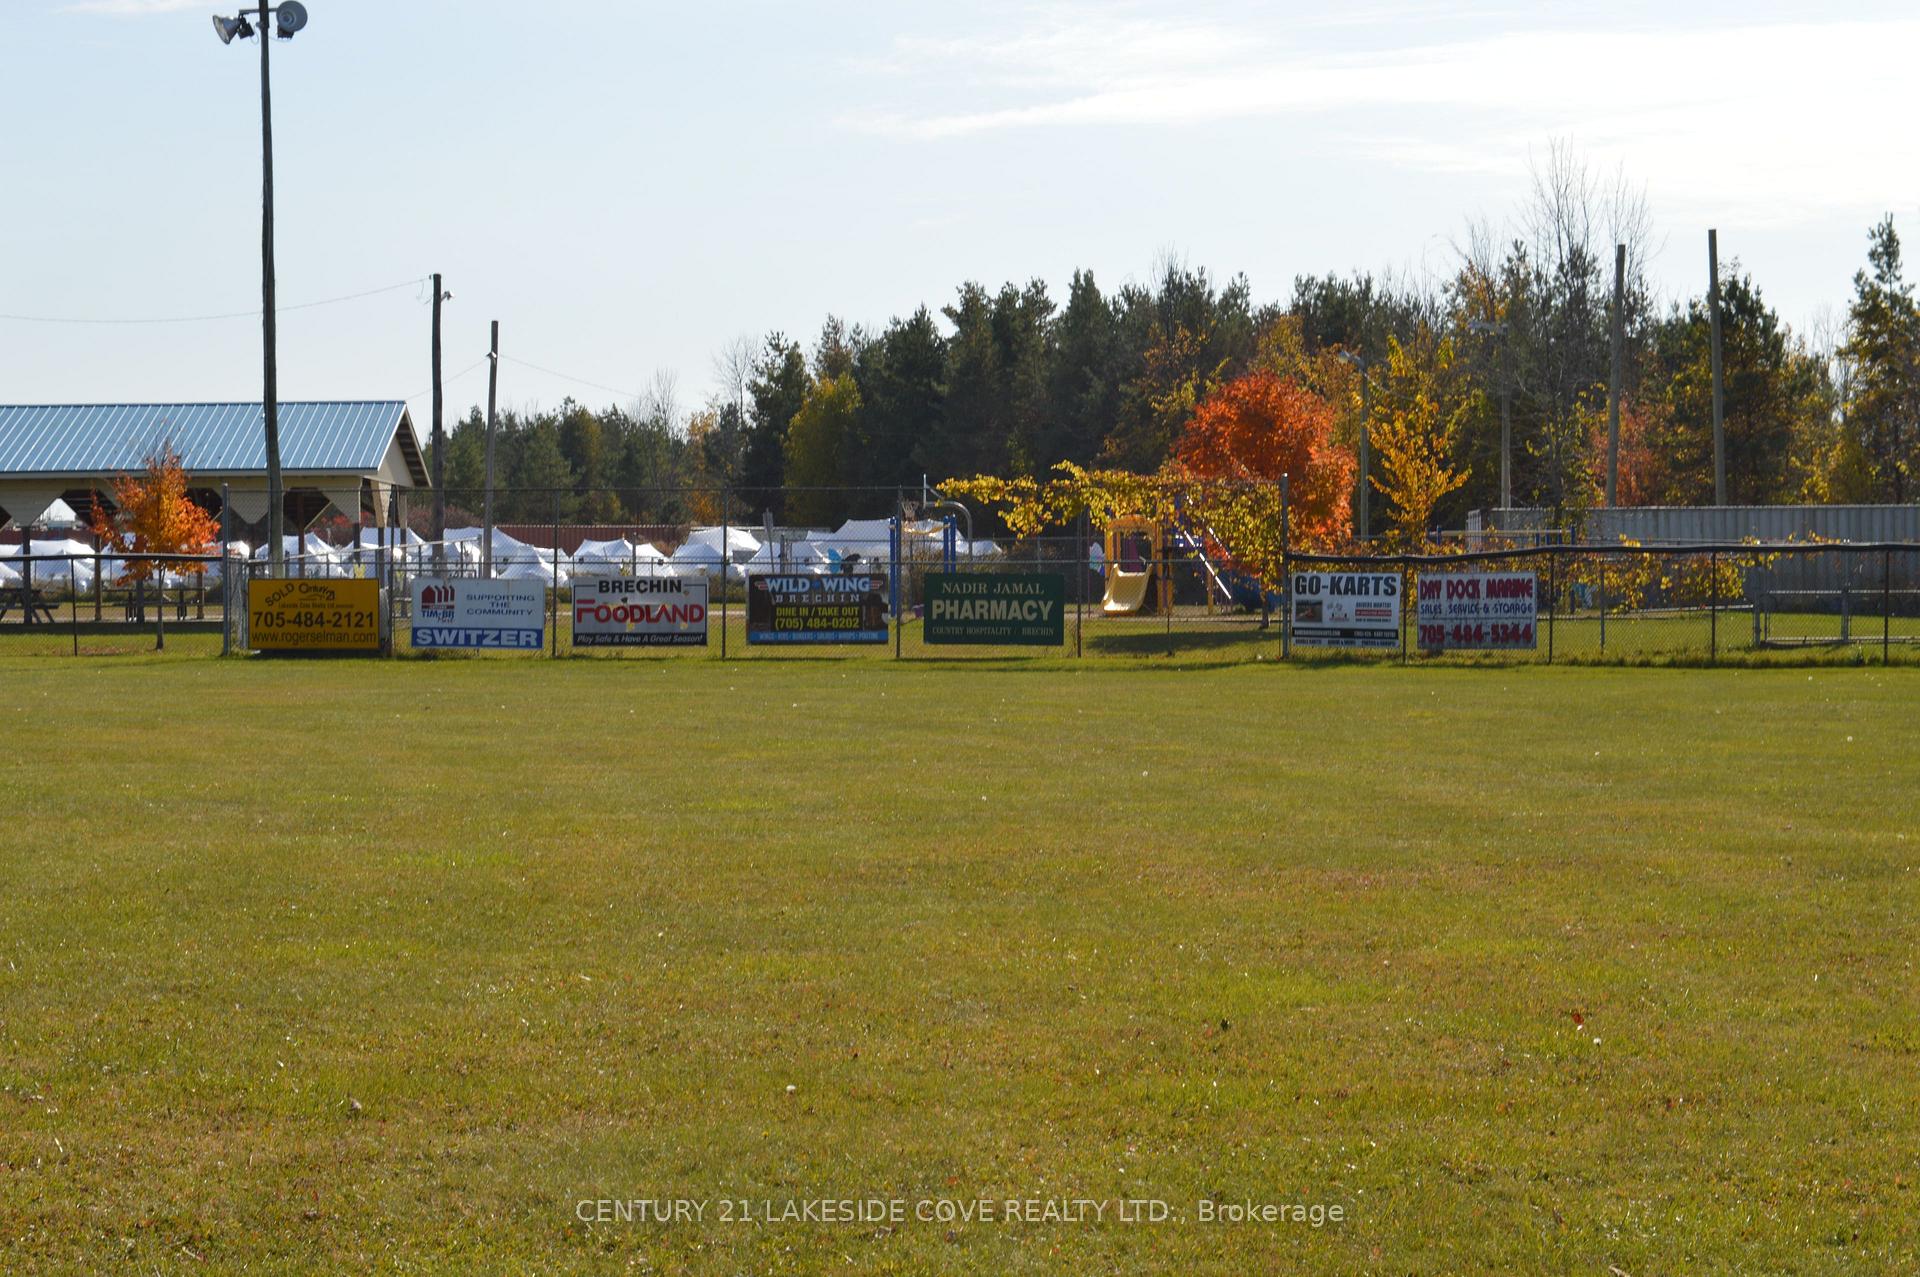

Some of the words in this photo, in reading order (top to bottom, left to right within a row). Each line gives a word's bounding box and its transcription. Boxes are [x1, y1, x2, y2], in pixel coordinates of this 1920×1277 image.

[598, 579, 682, 594] BRECHIN
[764, 577, 810, 592] WILD
[822, 577, 871, 592] WING
[942, 582, 988, 594] NADIR
[993, 582, 1045, 595] JAMAL
[1295, 575, 1397, 596] GO-KARTS
[1420, 579, 1442, 600] DAY
[1446, 579, 1481, 600] DOCK
[1486, 578, 1533, 599] MARINE
[264, 583, 295, 607] SOLD
[775, 593, 861, 603] BRECHIN
[576, 599, 704, 624] FOODLAND
[776, 607, 797, 616] DINE
[799, 607, 809, 616] IN
[817, 607, 839, 616] TAKE
[842, 607, 860, 616] OUT
[931, 599, 1054, 621] PHARMACY
[1420, 603, 1442, 615] SALES
[1448, 603, 1479, 614] SERVICE
[1494, 602, 1533, 614] STORAGE
[253, 611, 374, 628] 705-484-2121
[775, 617, 803, 631] (705)
[806, 617, 860, 629] 484-0202
[252, 631, 377, 646] www.rogerselman.com
[416, 628, 538, 646] SWITZER
[966, 626, 1012, 636] HOSPITALITY
[577, 635, 594, 645] Play
[595, 634, 612, 642] Safe
[613, 634, 619, 642] &
[621, 634, 641, 642] Have
[642, 634, 649, 642] A
[650, 634, 672, 642] Great
[672, 634, 703, 642] Season!
